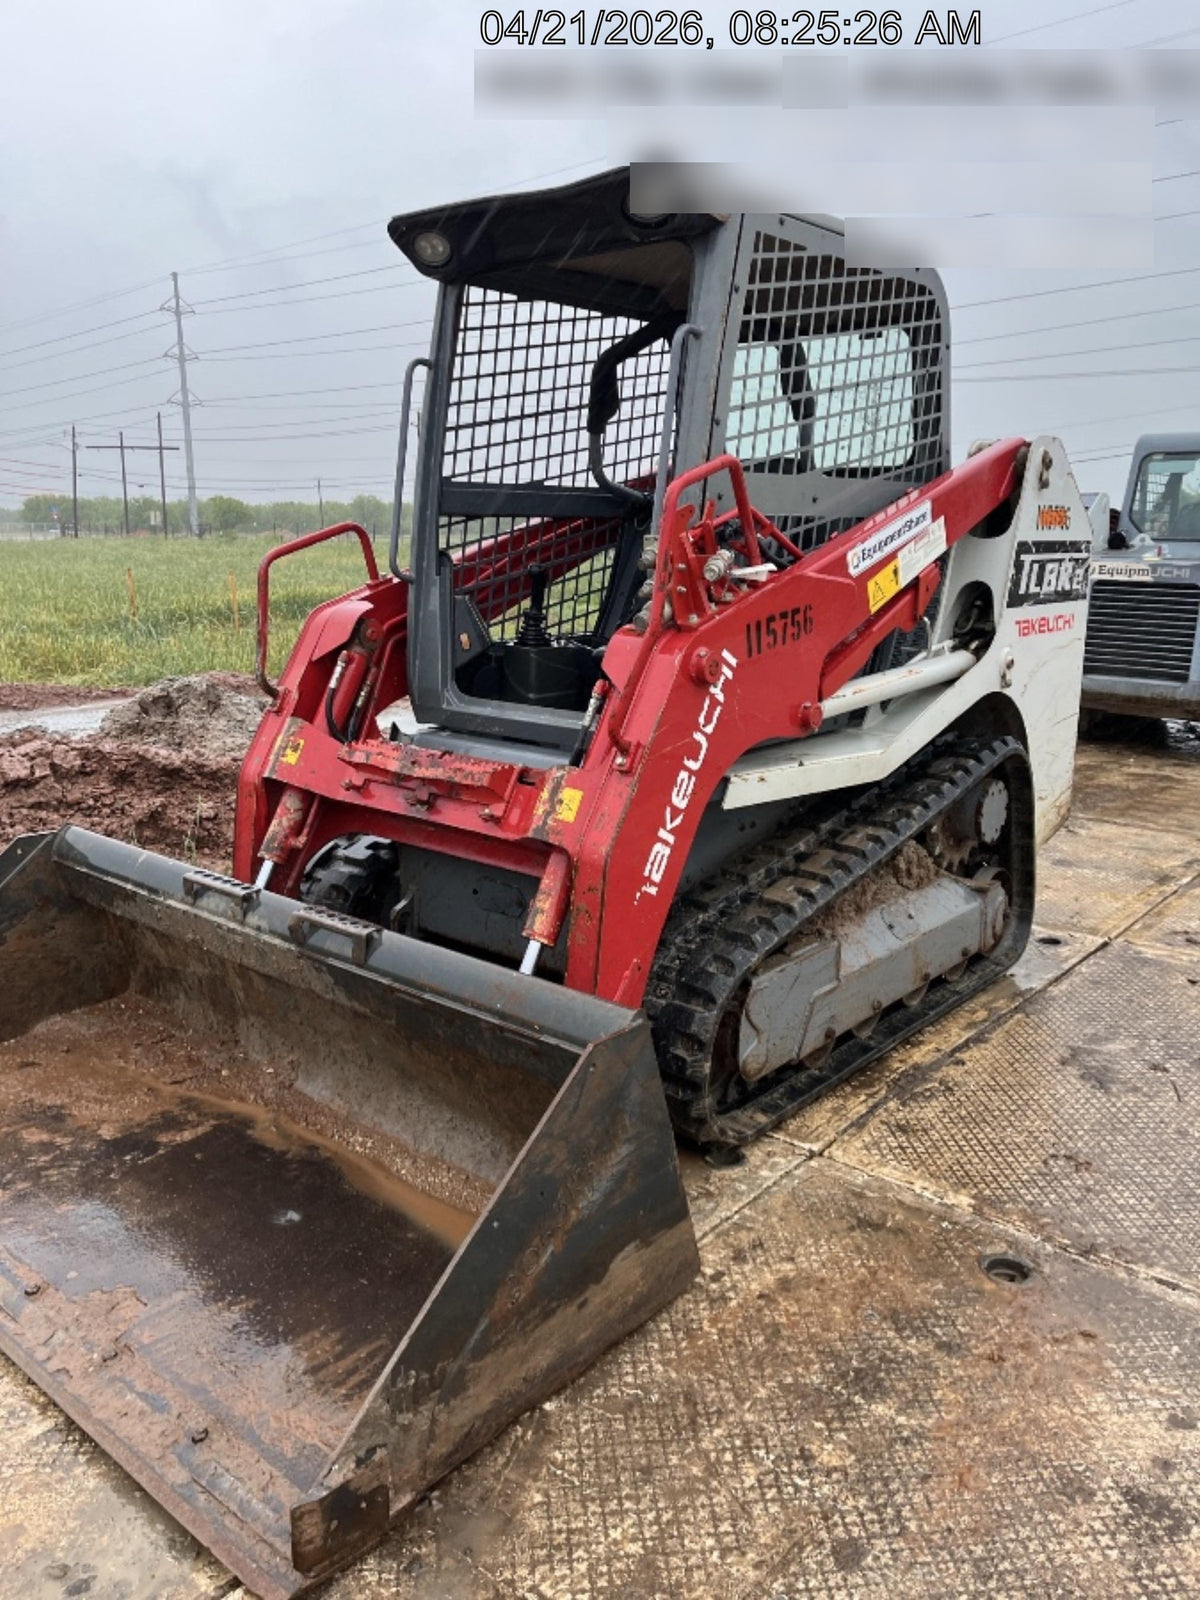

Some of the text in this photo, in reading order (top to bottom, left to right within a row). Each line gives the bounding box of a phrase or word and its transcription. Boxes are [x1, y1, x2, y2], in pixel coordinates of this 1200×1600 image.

[745, 604, 813, 659] 115756
[1014, 613, 1075, 638] TAKEUCHI
[634, 647, 738, 906] TAKEUCHI
